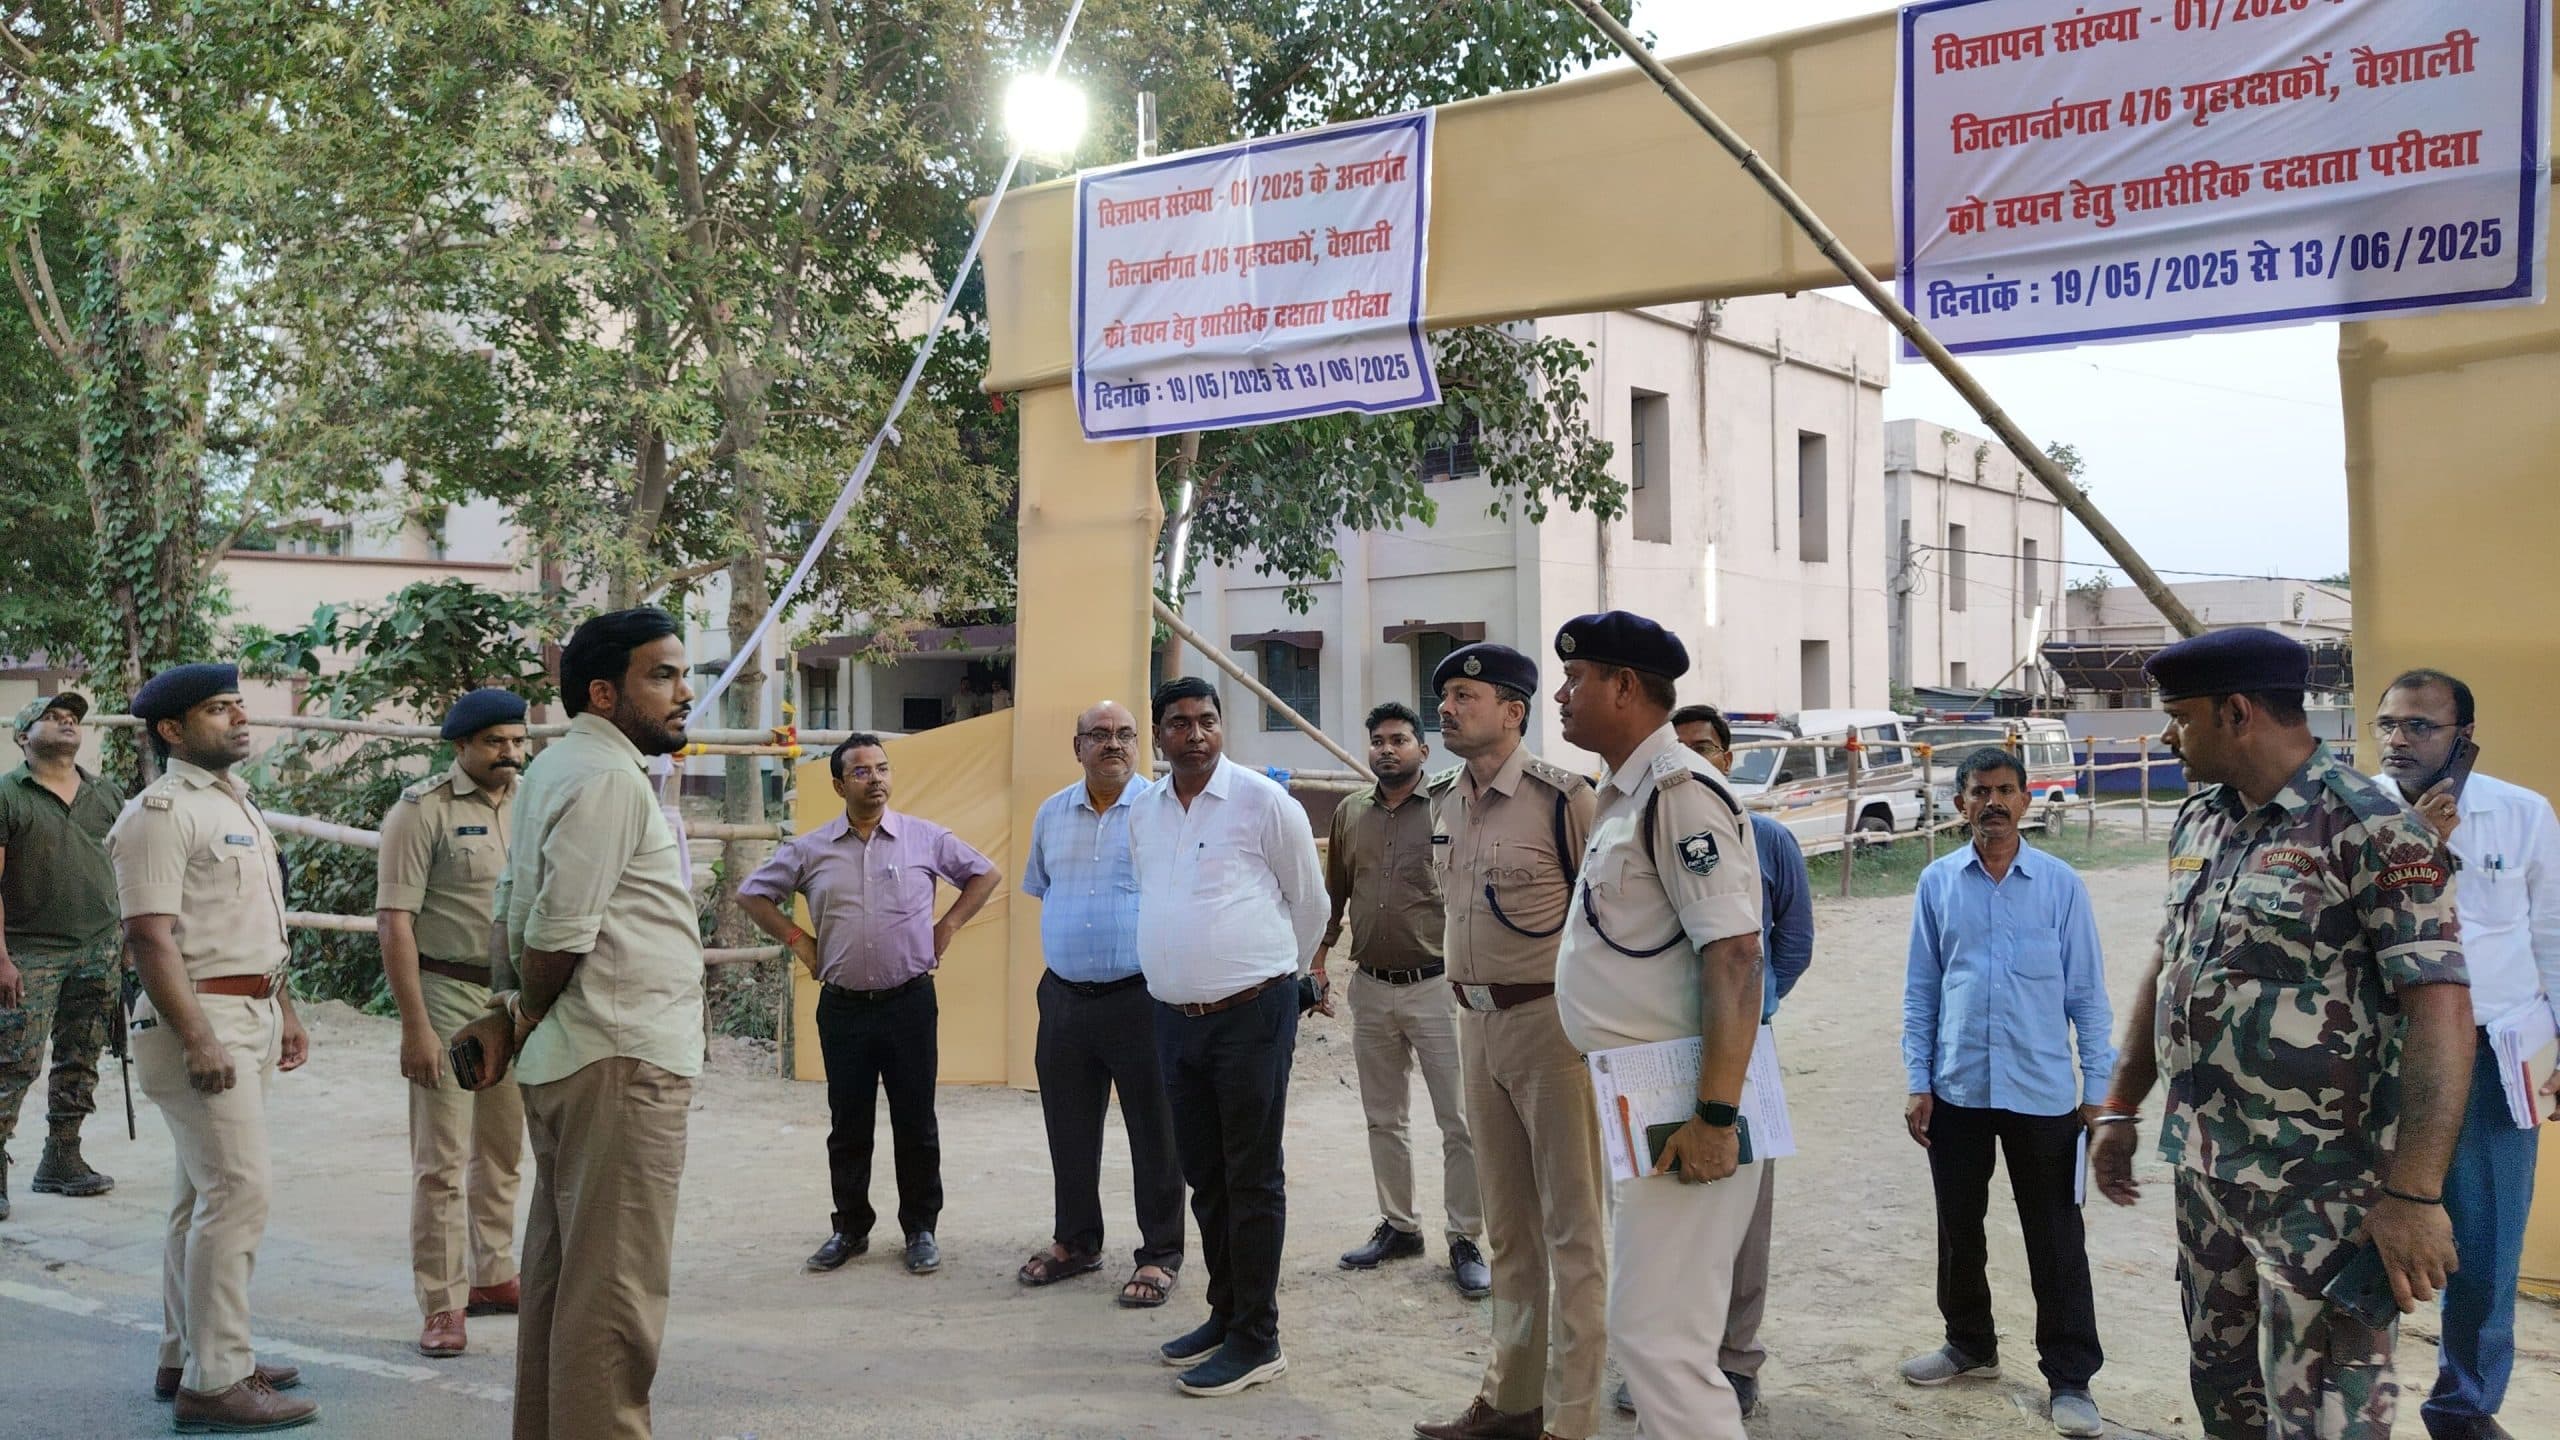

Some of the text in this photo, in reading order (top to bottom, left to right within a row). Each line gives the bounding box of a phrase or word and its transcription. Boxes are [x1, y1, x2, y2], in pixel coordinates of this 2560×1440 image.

[1932, 25, 2046, 74] विज्ञापन
[2052, 8, 2142, 52] संख्या
[2120, 86, 2172, 127] 476
[2180, 52, 2340, 127] गृहरक्षकों,
[2350, 29, 2479, 88] वैशाली
[1097, 198, 1162, 228] विज्ञापन
[1165, 185, 1214, 218] संख्या
[1231, 169, 1304, 207] 01/2025
[1308, 162, 1331, 194] के
[1335, 150, 1407, 191] अन्तर्गत
[1946, 129, 2483, 235] को चयन हेतु शारीरिक दक्षता परीक्षा
[1202, 247, 1229, 276] 476
[1325, 219, 1393, 258] वैशाली
[1927, 273, 2021, 319] दिनांक
[2051, 248, 2239, 306] 19/05/2025
[2248, 240, 2280, 283] से
[2290, 218, 2501, 280] 13/06/2025
[1103, 290, 1392, 349] को चयन हेतु शारीरिक दक्षता परीक्षा
[1094, 377, 1150, 410] दिनांक
[1167, 368, 1272, 404] 19/05/2025
[1272, 362, 1294, 391] से
[1294, 353, 1410, 388] 13/06/2025
[2266, 853, 2311, 871] COMMANDO
[2382, 867, 2439, 886] COMMANDO
